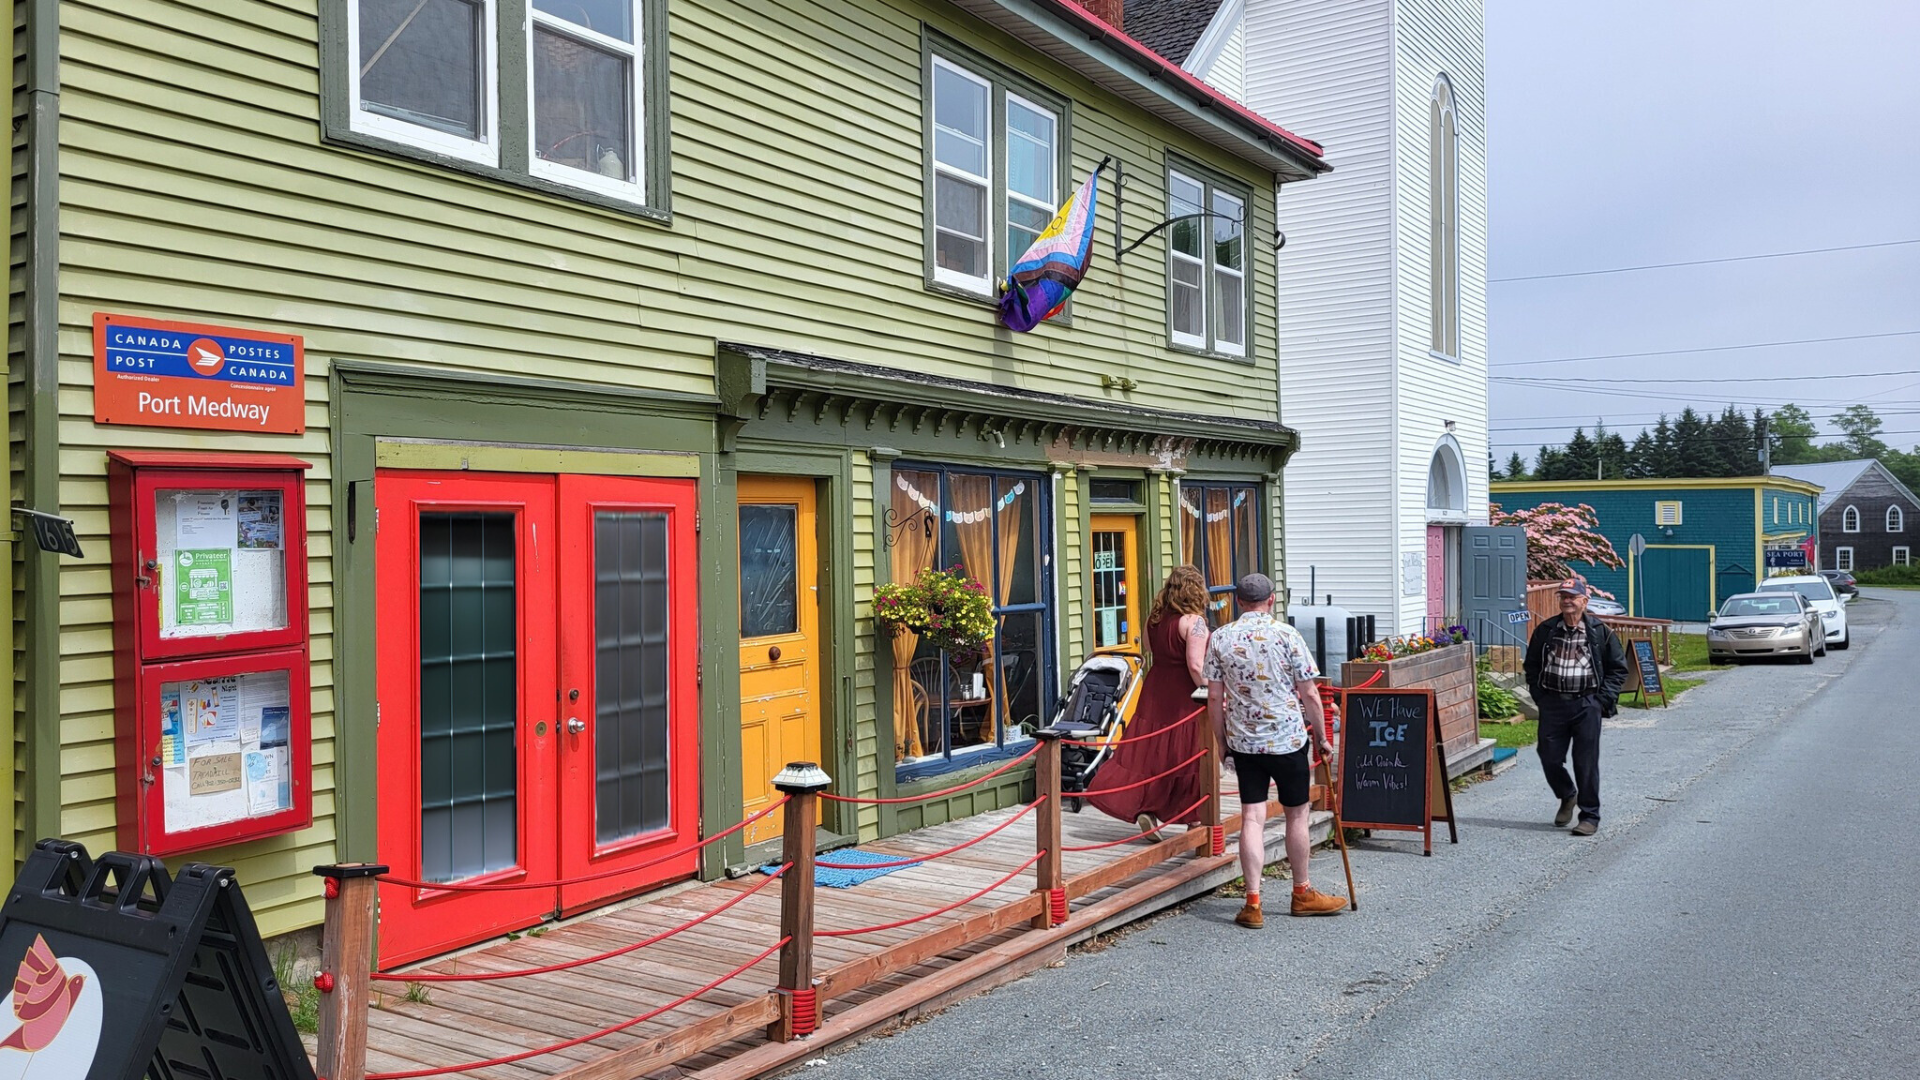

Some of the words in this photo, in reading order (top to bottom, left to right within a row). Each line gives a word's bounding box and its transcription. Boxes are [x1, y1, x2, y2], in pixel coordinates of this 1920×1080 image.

[115, 333, 182, 349] CANADA
[229, 345, 280, 359] POSTES
[115, 356, 155, 368] POST
[230, 366, 287, 380] CANADA
[138, 391, 181, 415] Port
[188, 395, 270, 425] Medway
[1510, 612, 1530, 622] OPEN
[1357, 697, 1384, 719] WE
[1388, 697, 1423, 719] Have
[1368, 721, 1408, 747] ICE
[193, 757, 212, 767] FOR
[213, 755, 233, 764] SALE
